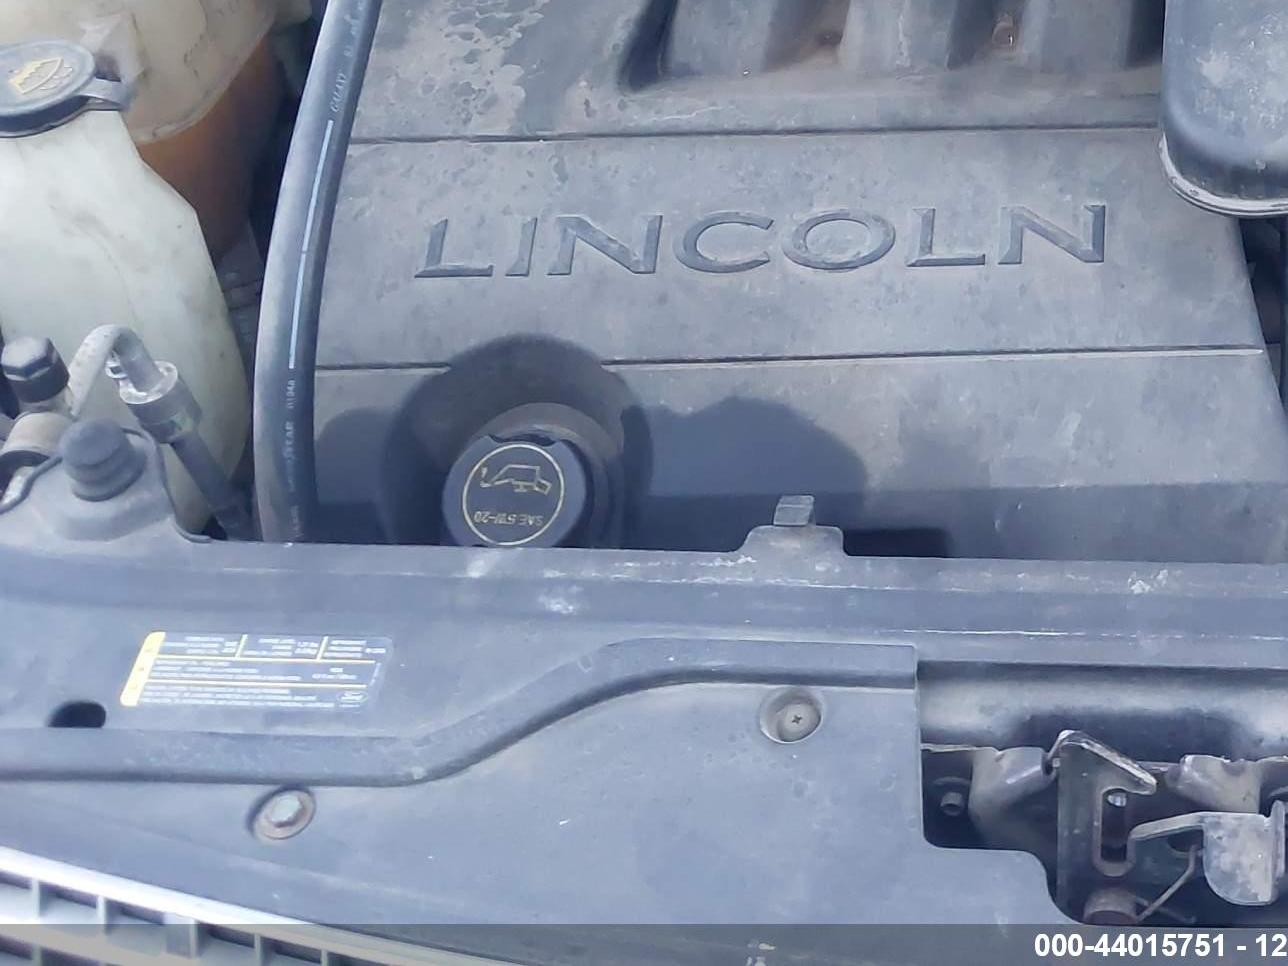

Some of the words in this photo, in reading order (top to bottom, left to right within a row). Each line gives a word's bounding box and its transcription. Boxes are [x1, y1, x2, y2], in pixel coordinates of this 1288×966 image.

[413, 202, 1107, 279] LINCOLN
[473, 511, 517, 525] 5W-20
[518, 514, 544, 527] SAE
